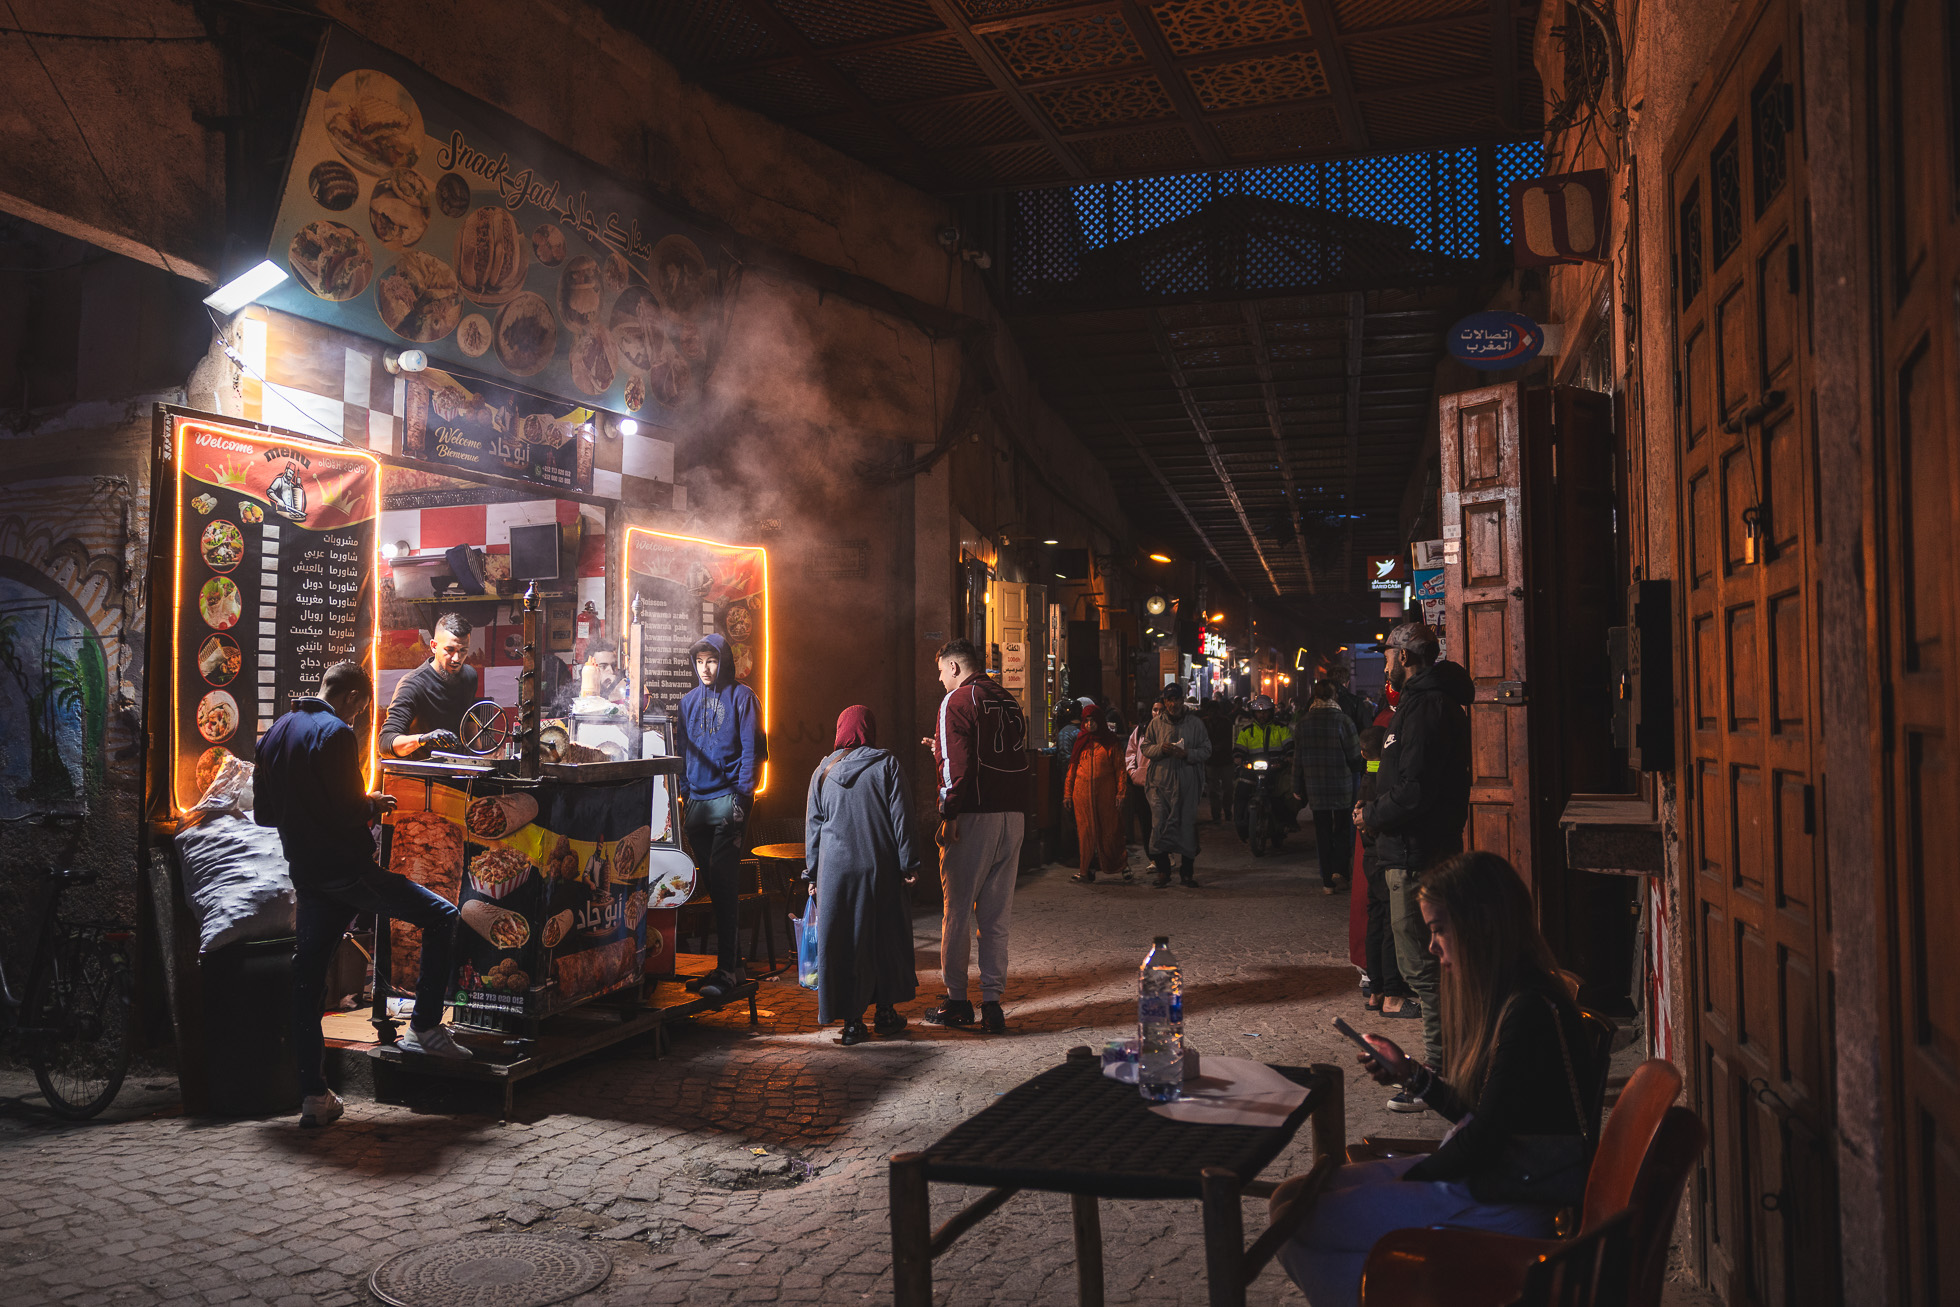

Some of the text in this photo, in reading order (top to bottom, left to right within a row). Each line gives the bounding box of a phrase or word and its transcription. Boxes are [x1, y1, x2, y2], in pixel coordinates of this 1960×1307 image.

[437, 130, 560, 211] Snack Jad
[560, 191, 599, 241] جاد
[1461, 329, 1512, 339] اتصالات
[1466, 341, 1511, 353] المغرب
[195, 432, 254, 455] Welcome
[435, 426, 482, 450] Welcome
[436, 444, 480, 463] Bienvenue
[489, 437, 512, 463] جاد
[264, 447, 312, 470] menu
[323, 534, 359, 547] مشروبات
[635, 540, 675, 553] Welcome
[304, 550, 358, 562] شاورما عربي
[293, 561, 358, 577] شاورما بالعيش
[302, 579, 358, 593] شاورما دوبل
[296, 594, 357, 608] شاورما مغربية
[300, 610, 356, 623] شاورما رويال
[290, 626, 355, 639] شاورما ميكست
[645, 633, 671, 641] hawarma
[328, 643, 355, 654] شاورما
[645, 645, 671, 653] hawarma
[300, 657, 321, 669] دجاج
[645, 656, 689, 667] hawarma Royal
[300, 672, 320, 682] كفتة
[645, 668, 672, 676] hawarma
[661, 680, 692, 688] Shawarma
[577, 893, 623, 930] أبو جاد
[468, 991, 524, 1005] +212 713 020 012
